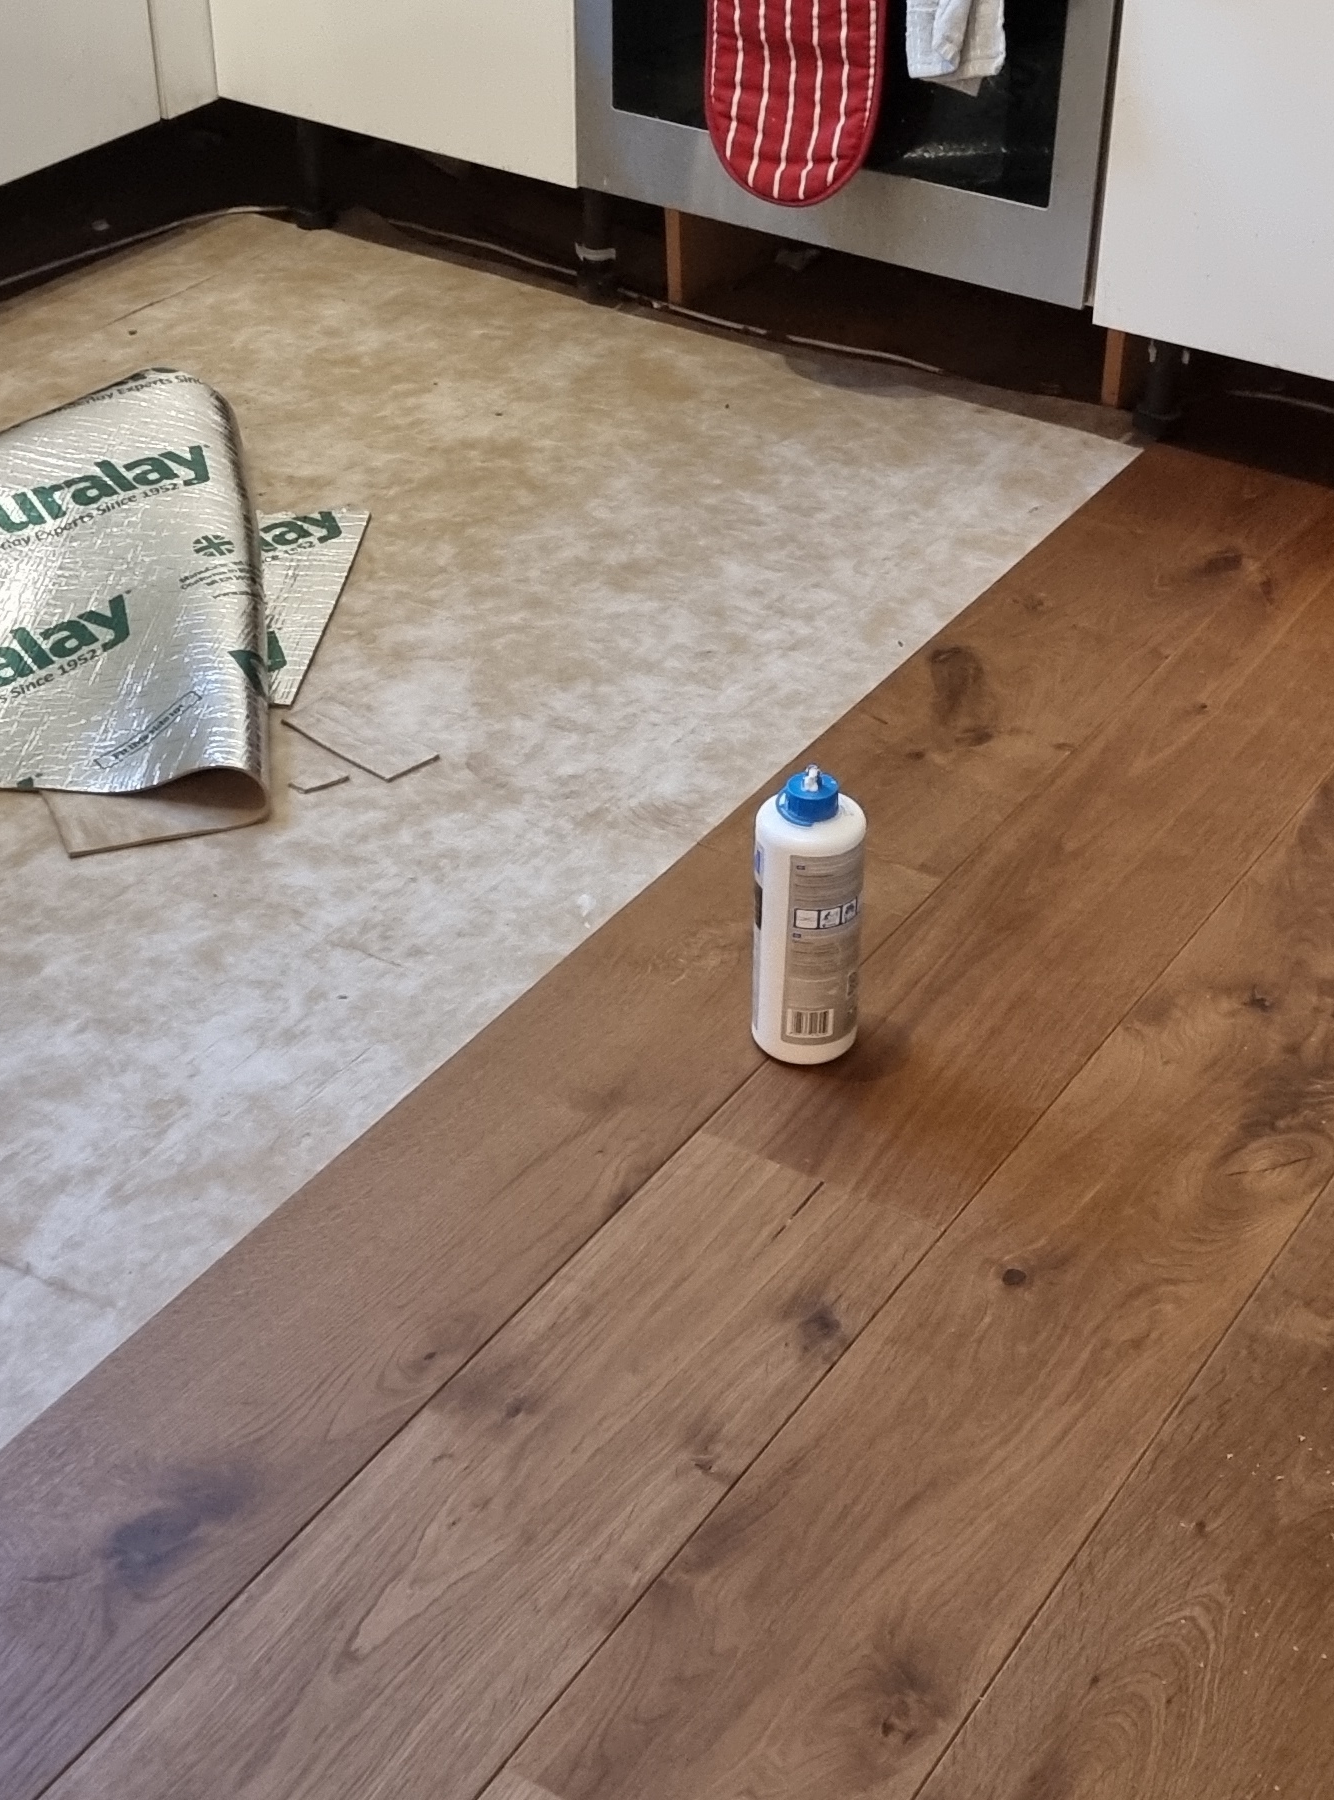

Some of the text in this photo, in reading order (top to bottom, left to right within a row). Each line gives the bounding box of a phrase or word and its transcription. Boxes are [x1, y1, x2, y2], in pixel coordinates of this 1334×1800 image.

[35, 511, 94, 542] Experts
[96, 494, 138, 515] Since
[141, 482, 180, 500] 1952
[11, 673, 55, 699] Since
[58, 649, 99, 676] 1952
